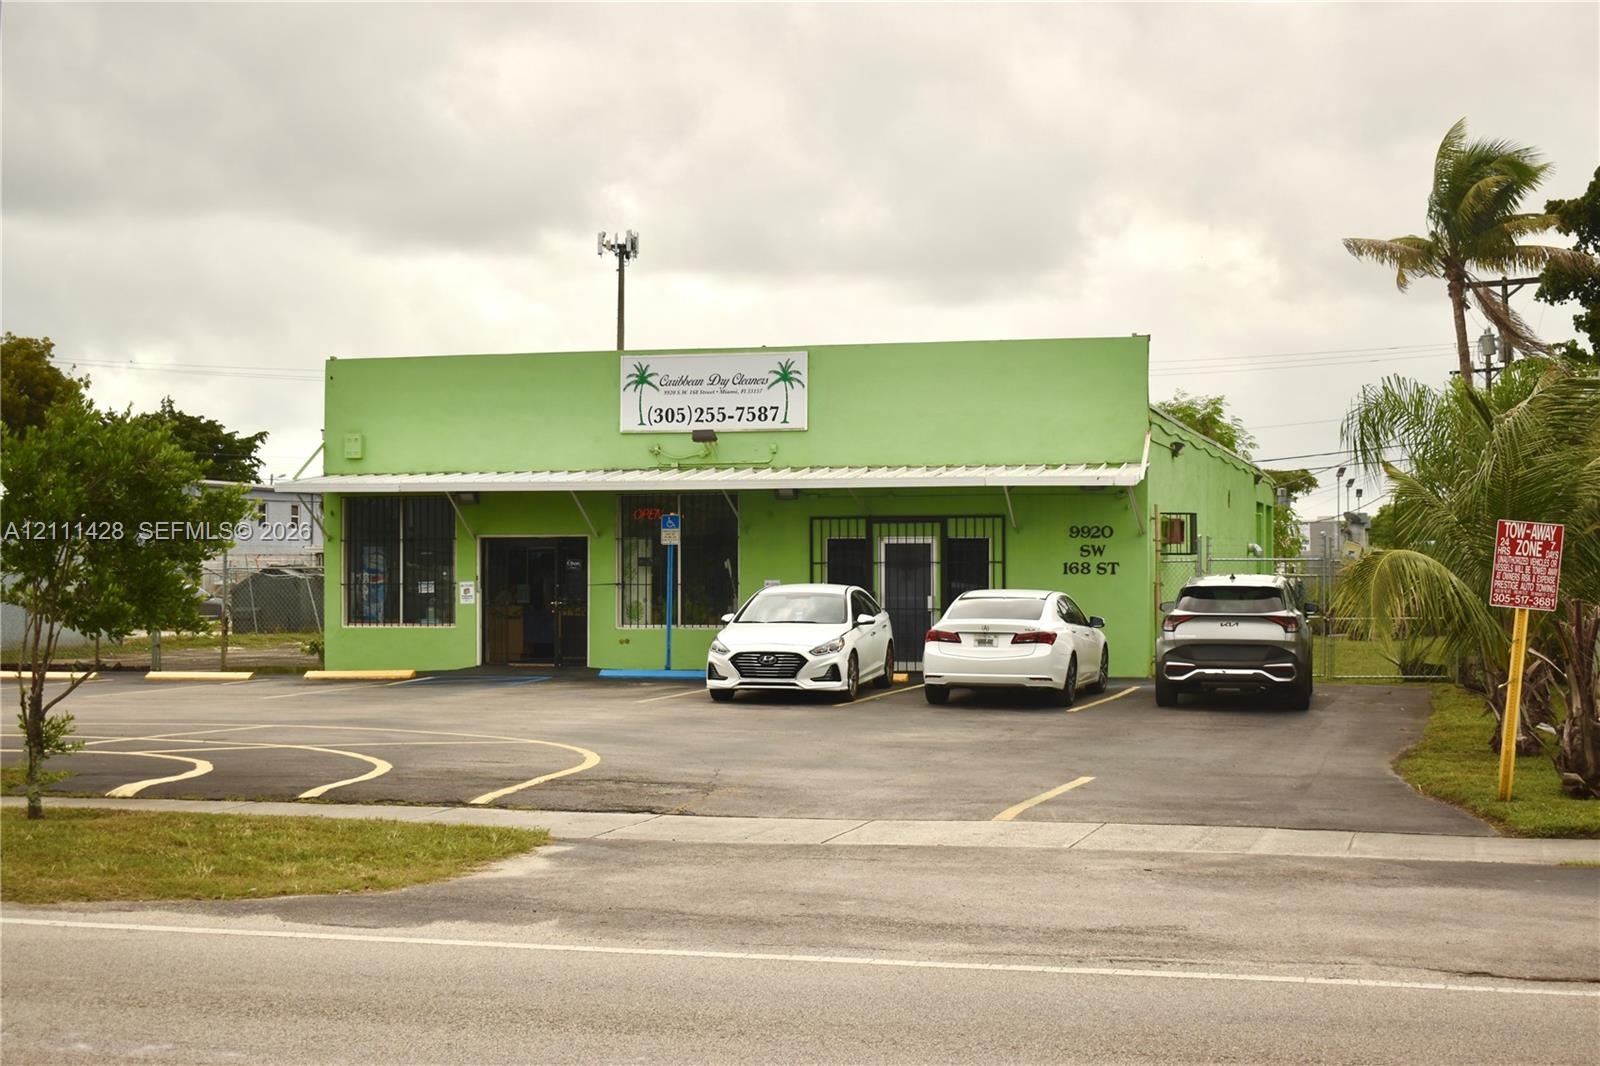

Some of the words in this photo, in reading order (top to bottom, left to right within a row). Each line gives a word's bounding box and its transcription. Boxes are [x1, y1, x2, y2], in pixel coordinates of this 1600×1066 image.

[660, 374, 704, 387] Caribbean
[707, 373, 730, 389] Dry
[732, 372, 769, 386] Cleaners
[647, 405, 780, 426] (305)255-7587
[1069, 525, 1114, 539] 9920
[1504, 522, 1557, 541] TOW-AWAY
[1500, 537, 1510, 546] 24
[1515, 539, 1543, 557] ZONE
[1550, 541, 1556, 550] 7
[1080, 544, 1106, 557] SW
[1497, 546, 1511, 555] HRS
[1545, 550, 1559, 559] DAYS
[1063, 561, 1091, 575] 168
[1096, 561, 1120, 575] ST
[1492, 593, 1555, 607] 305-517-3681
